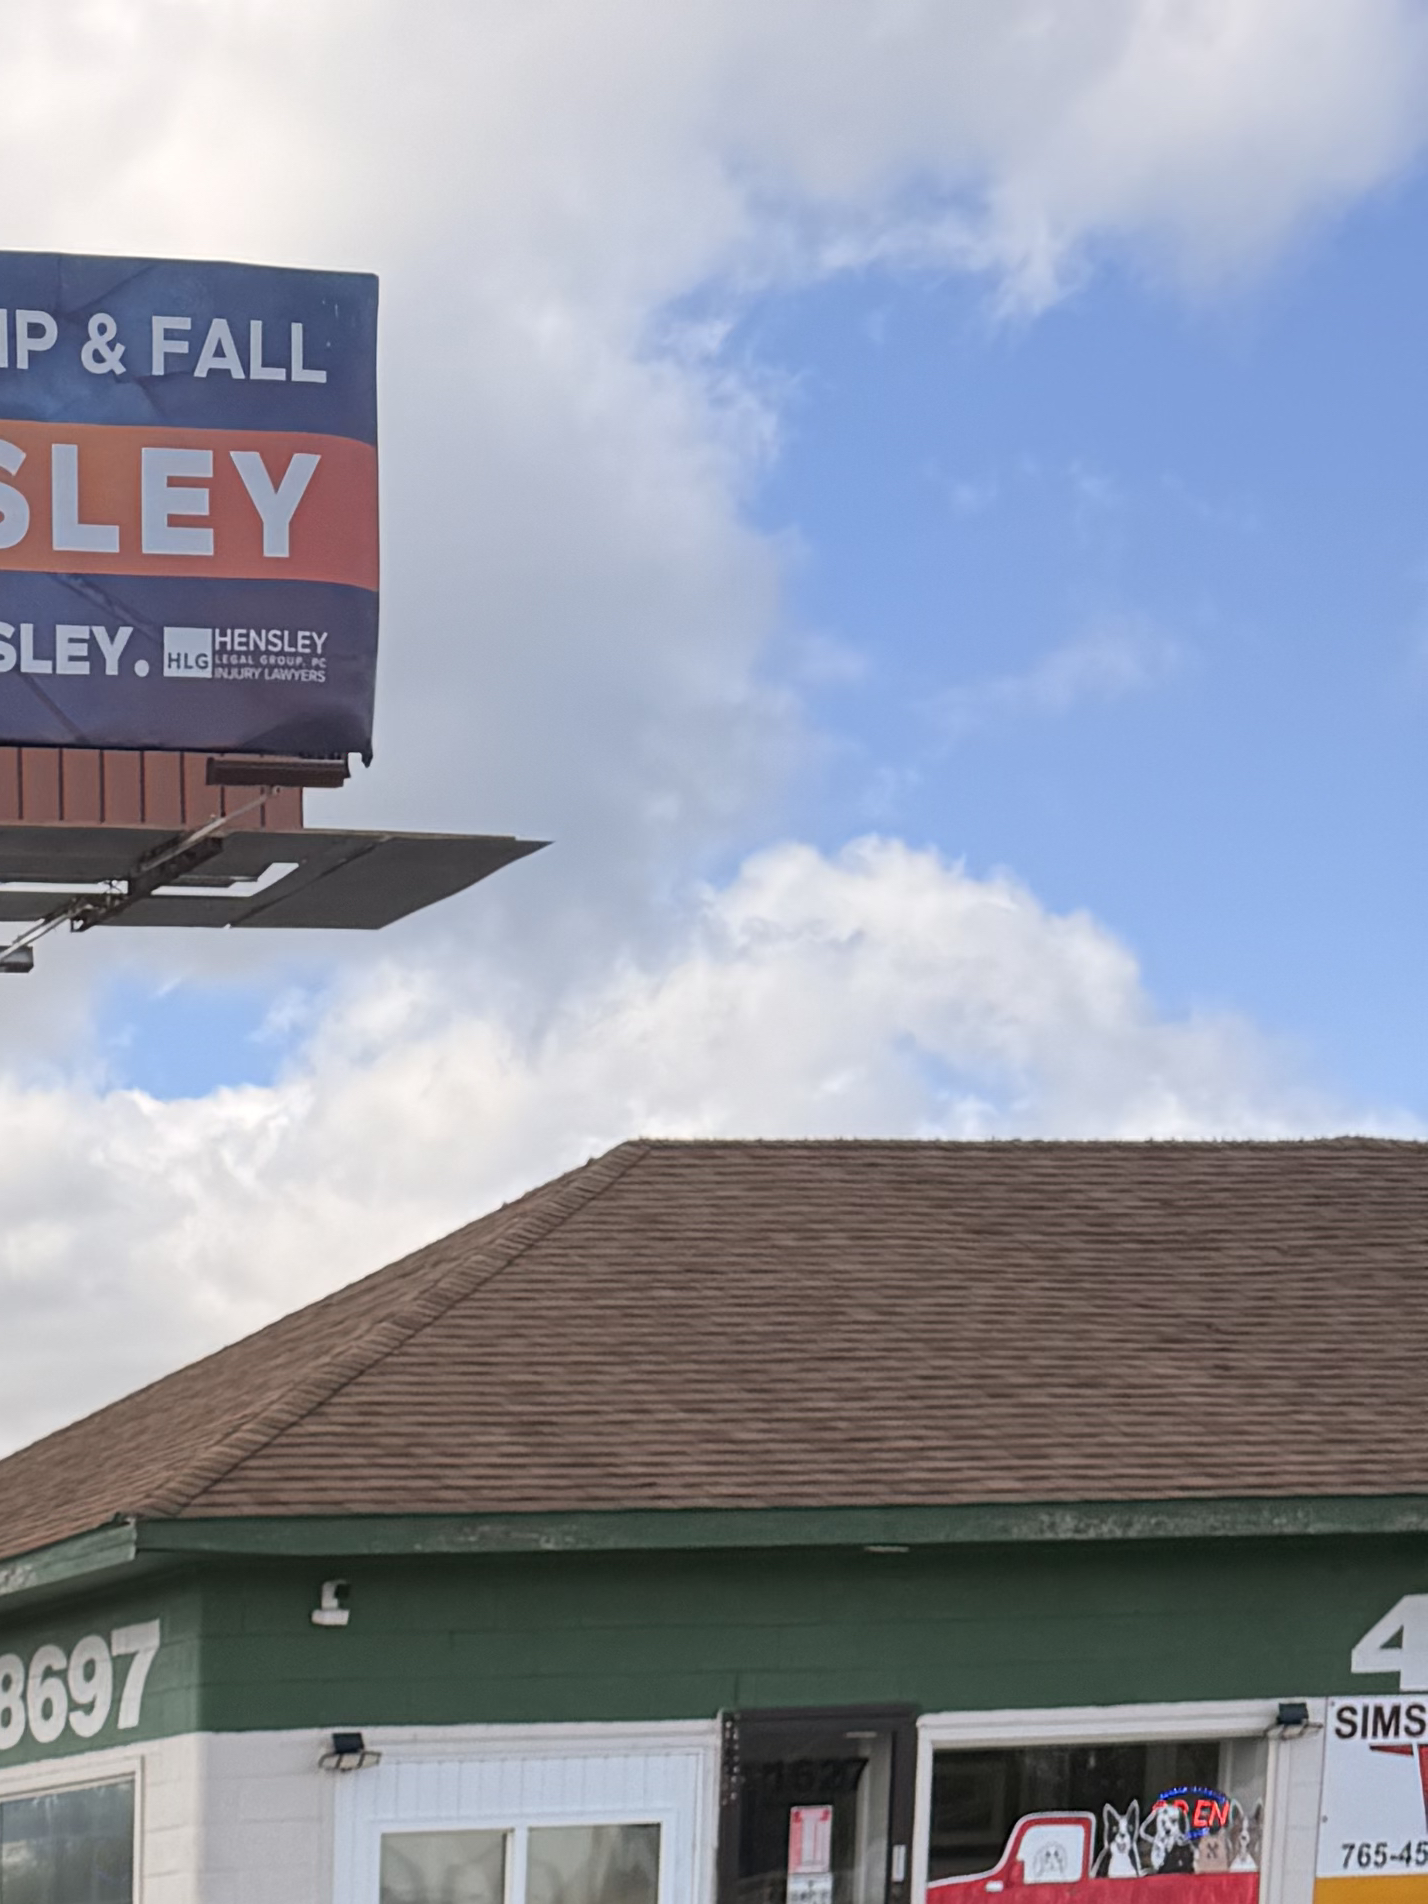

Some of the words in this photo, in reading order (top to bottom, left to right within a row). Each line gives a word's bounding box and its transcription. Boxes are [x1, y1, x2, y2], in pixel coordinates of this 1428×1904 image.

[80, 311, 127, 375] &
[150, 315, 329, 385] FALL
[215, 628, 328, 654] HENSLEY
[167, 652, 209, 670] HLG
[215, 654, 253, 664] LEGAL
[311, 658, 326, 668] PC
[214, 667, 263, 679] INJURY
[264, 668, 326, 682] LAWYERS
[1335, 1704, 1427, 1739] SIMS
[1152, 1799, 1230, 1828] EN
